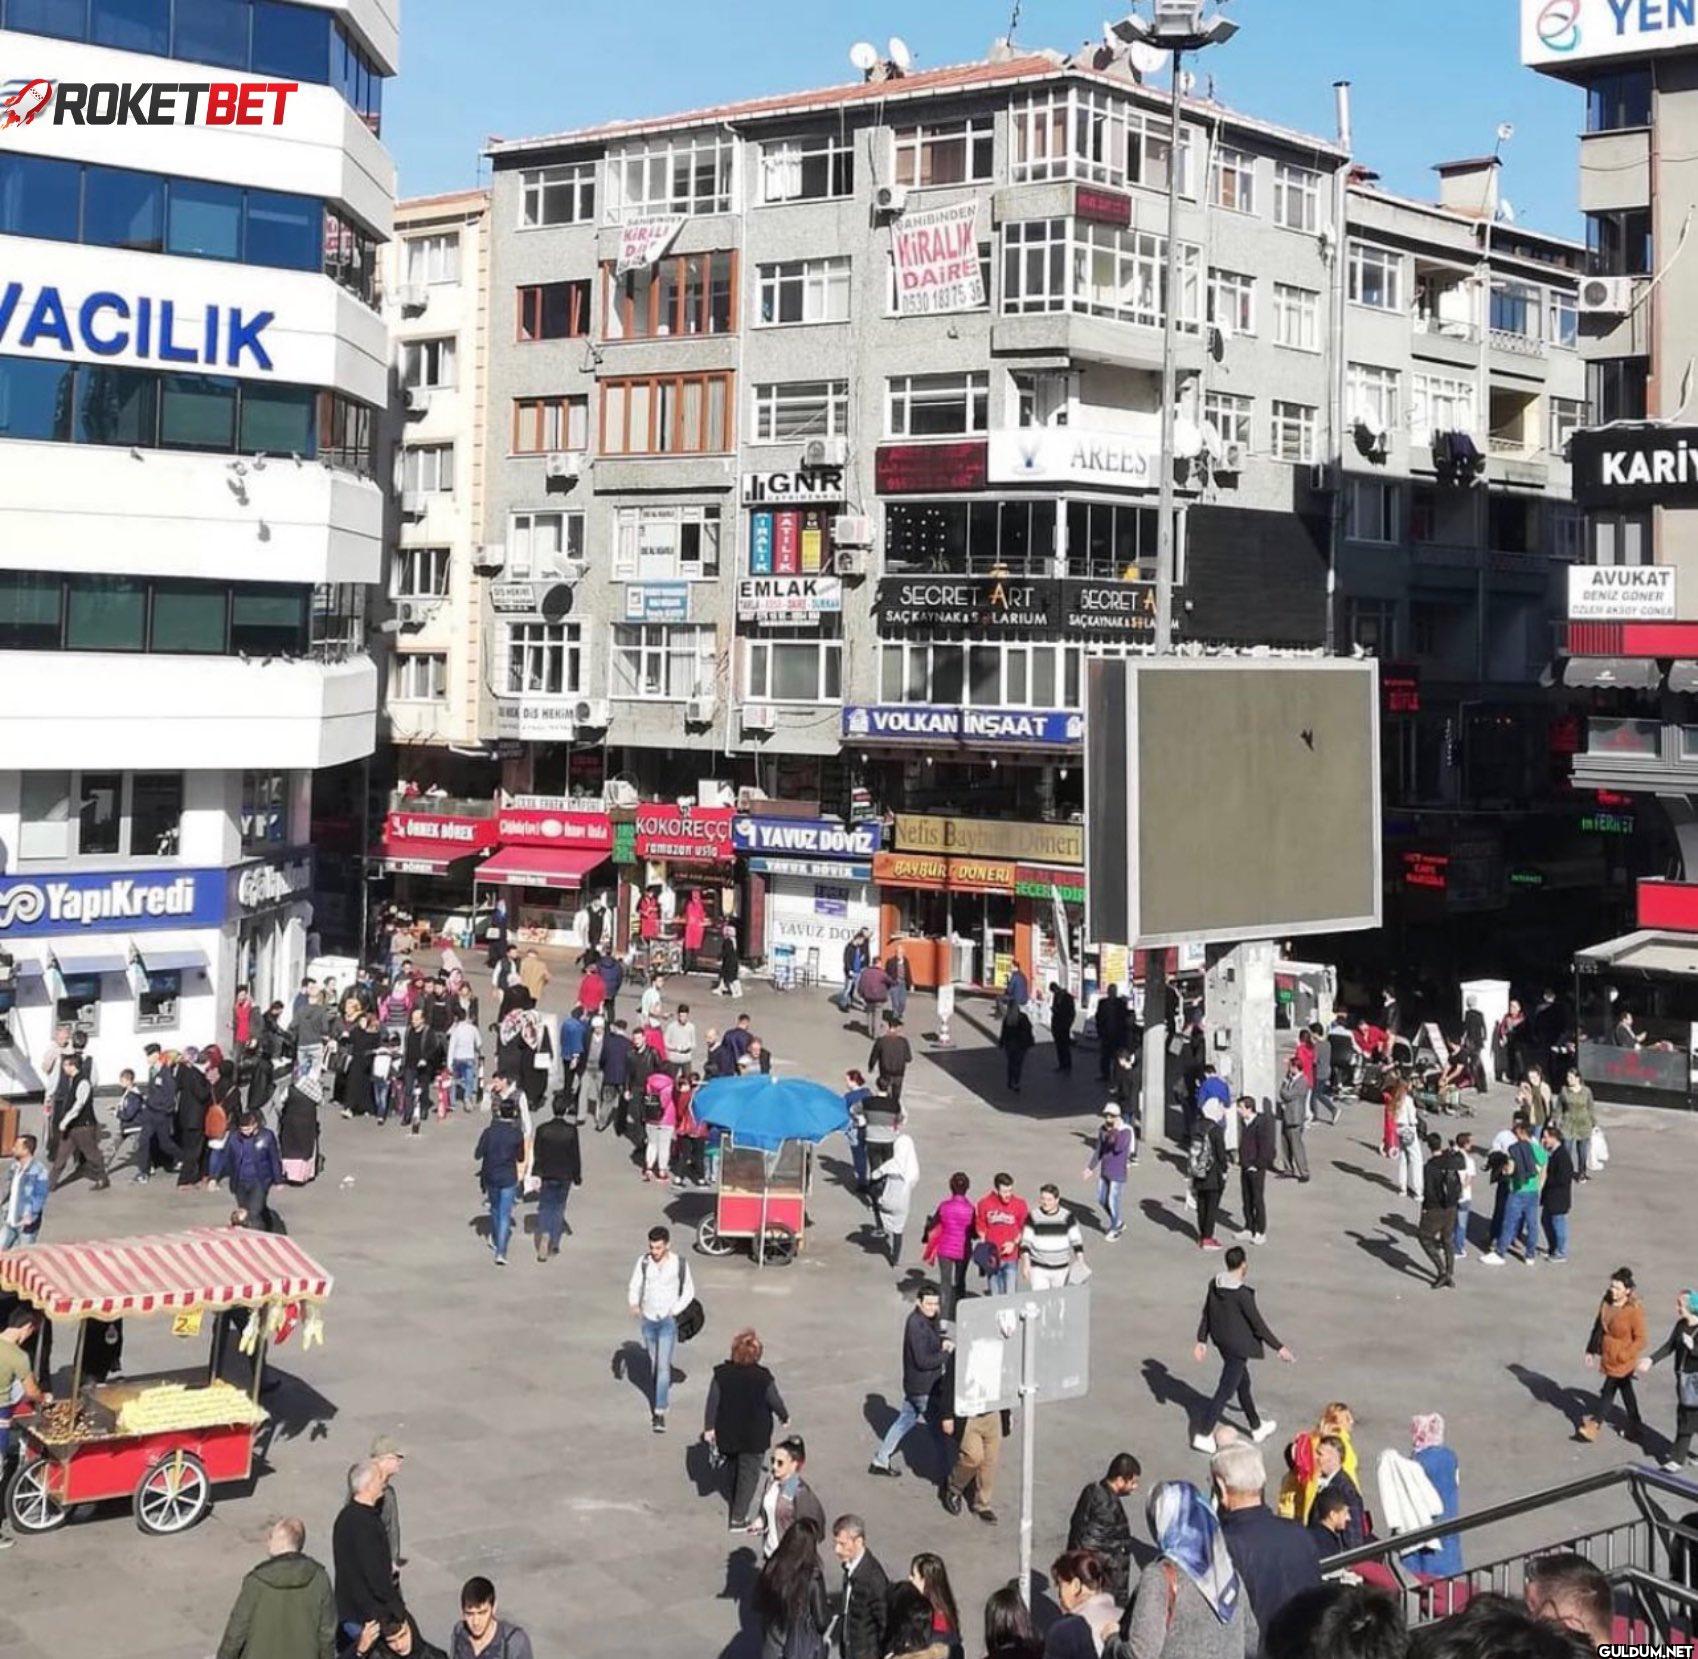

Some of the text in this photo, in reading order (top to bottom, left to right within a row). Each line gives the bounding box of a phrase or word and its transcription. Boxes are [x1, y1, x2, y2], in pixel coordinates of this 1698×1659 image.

[902, 257, 978, 291] DAİRE
[1070, 445, 1147, 475] AREES
[768, 473, 843, 494] GNR
[741, 581, 817, 597] EMLAK
[1592, 571, 1670, 586] AVUKAT
[900, 586, 981, 606] SECRET
[873, 709, 1048, 738] VOLKAN İNŞAAT
[760, 825, 818, 850] YAVUZ
